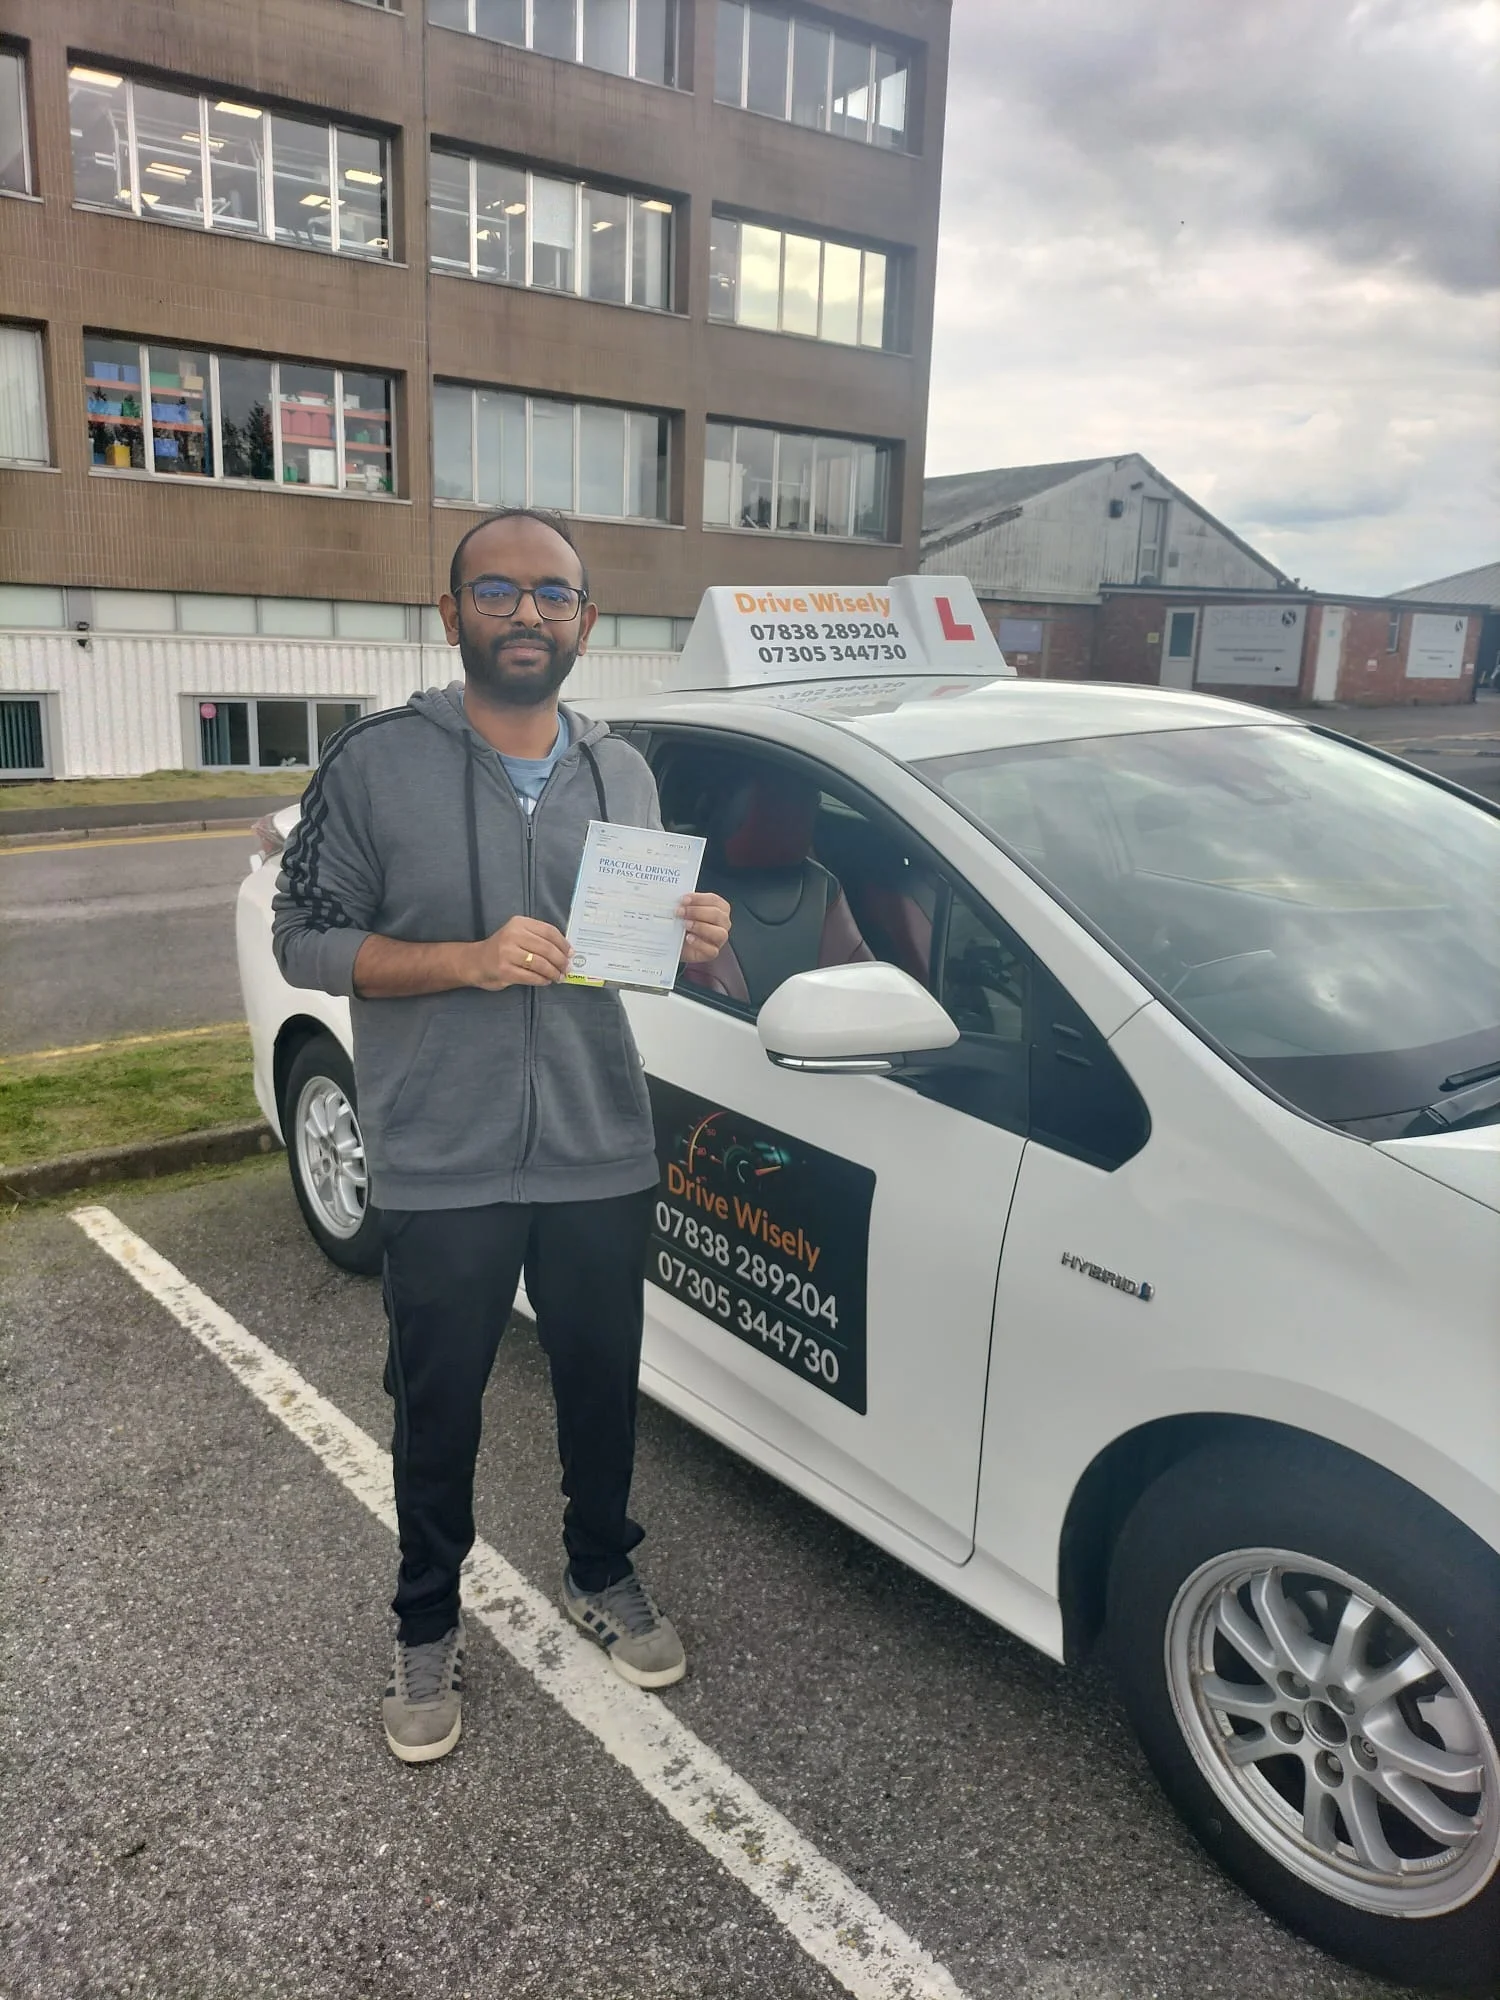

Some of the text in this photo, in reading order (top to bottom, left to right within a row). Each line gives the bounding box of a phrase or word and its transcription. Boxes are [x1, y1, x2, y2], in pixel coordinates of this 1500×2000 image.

[734, 592, 890, 618] Drive Wisely
[934, 597, 975, 641] L
[750, 622, 899, 641] 07838 289204
[758, 643, 907, 664] 07305 344730
[598, 866, 615, 875] TEST
[616, 868, 634, 878] PASS
[635, 870, 679, 885] CERTIFICATE
[599, 857, 681, 877] PRACTICAL DRIVING
[667, 1162, 821, 1272] Drive Wisely
[655, 1201, 839, 1329] 07838 289204
[1060, 1251, 1139, 1298] HYBRID
[657, 1250, 840, 1384] 07305 344730
